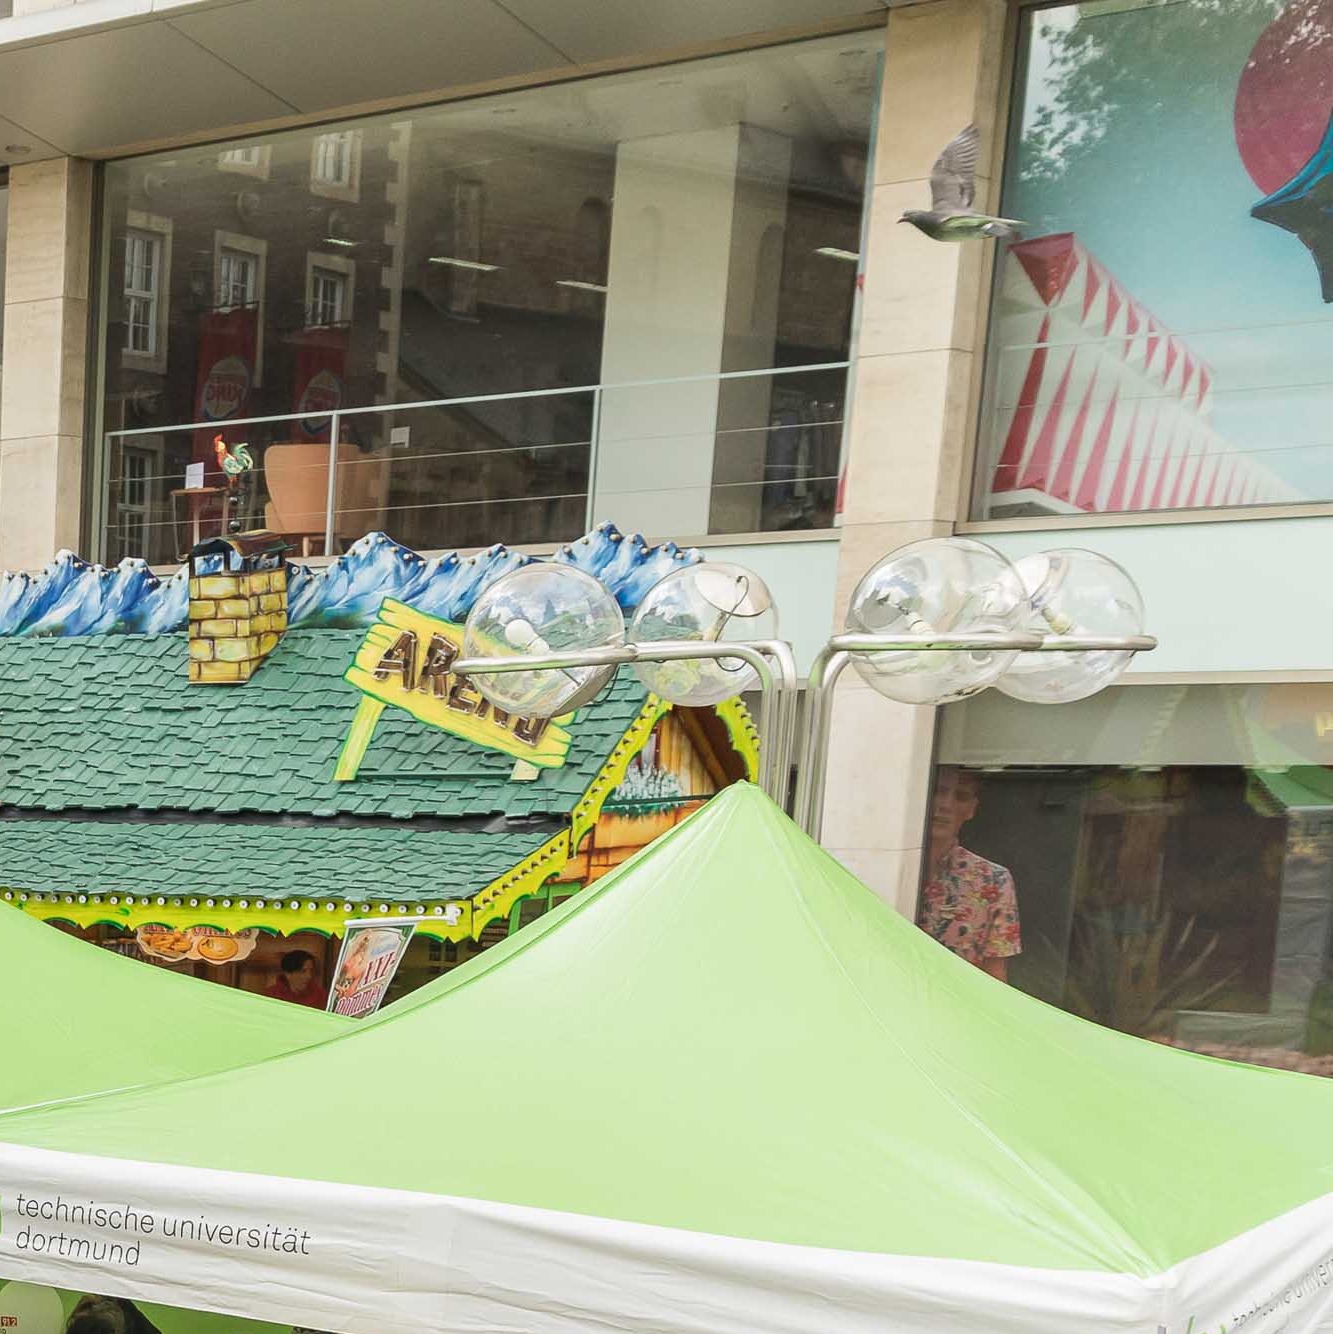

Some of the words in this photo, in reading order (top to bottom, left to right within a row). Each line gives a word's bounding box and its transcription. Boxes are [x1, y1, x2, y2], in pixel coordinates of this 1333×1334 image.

[16, 1193, 155, 1234] technische
[162, 1214, 312, 1256] universität
[16, 1226, 141, 1267] dortmund
